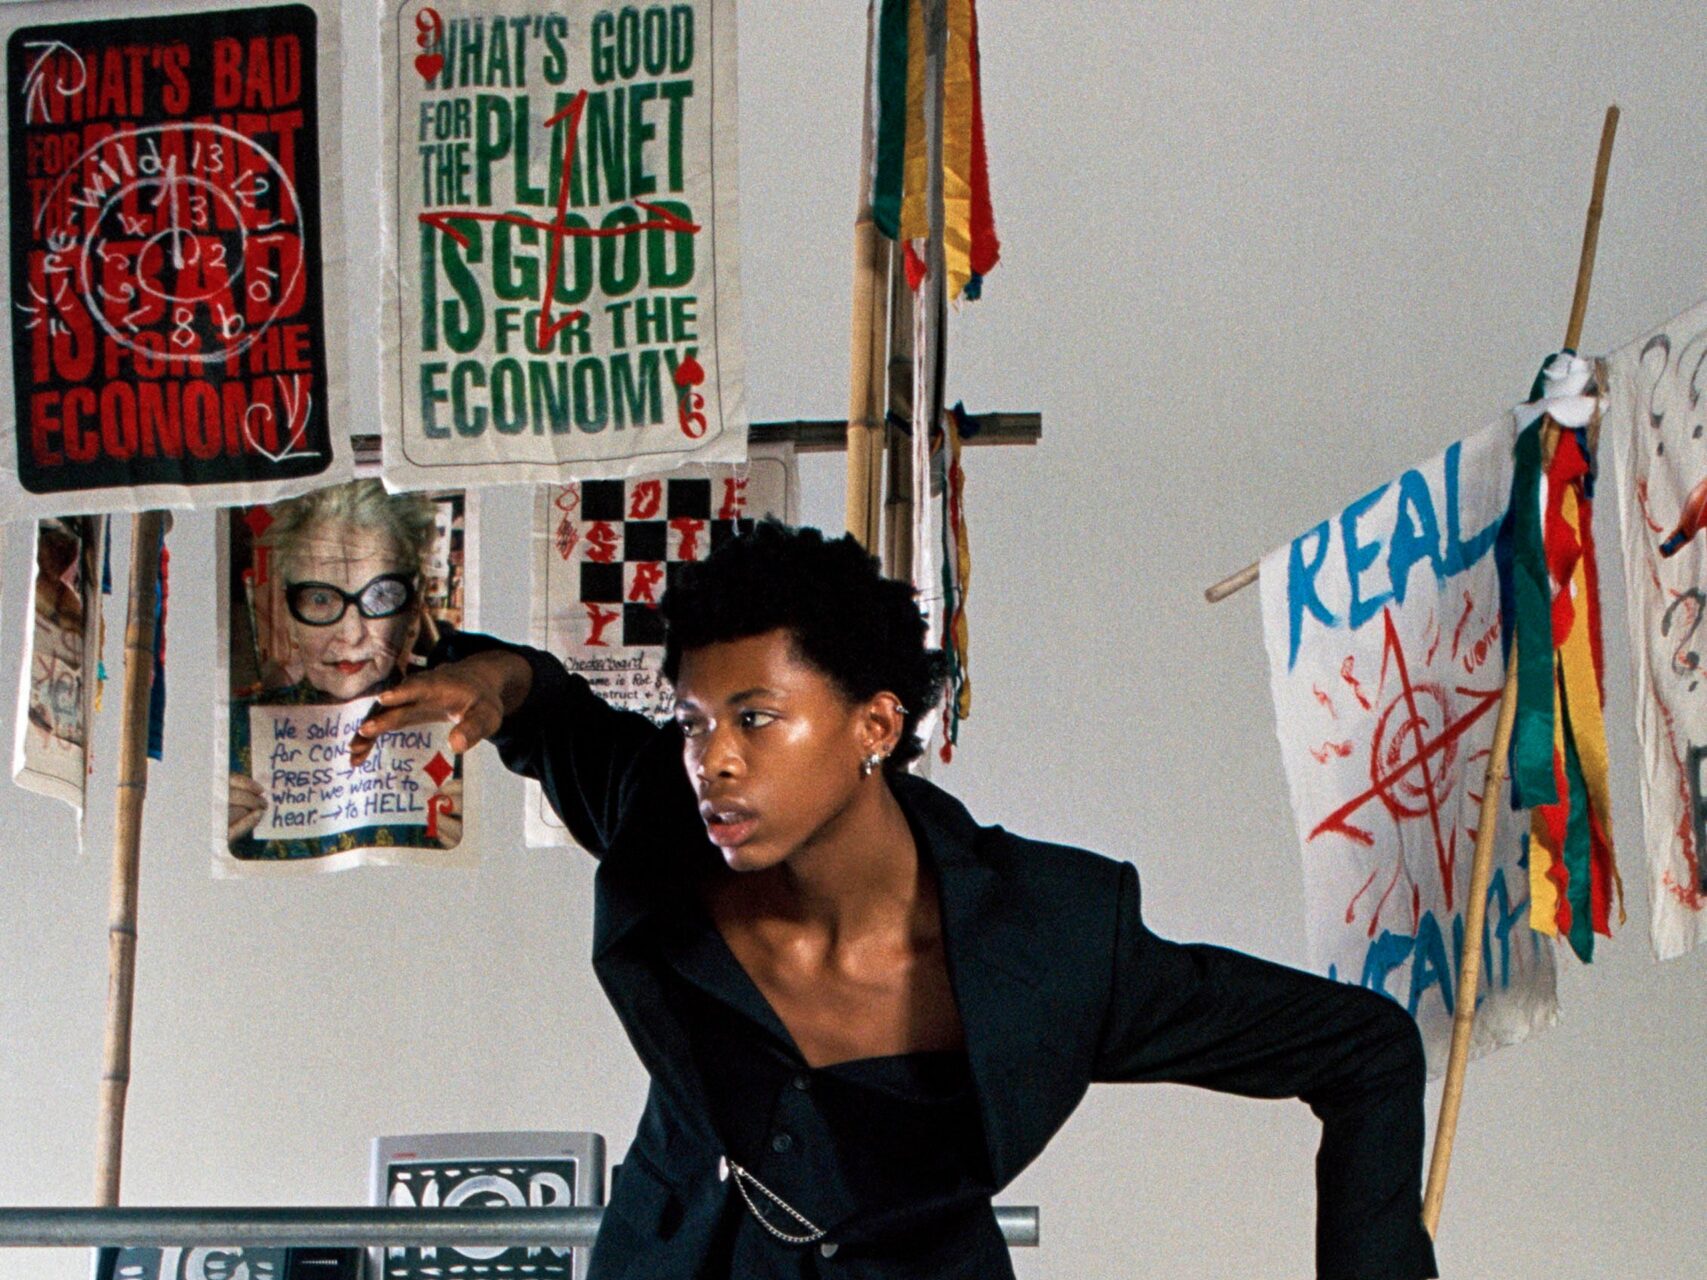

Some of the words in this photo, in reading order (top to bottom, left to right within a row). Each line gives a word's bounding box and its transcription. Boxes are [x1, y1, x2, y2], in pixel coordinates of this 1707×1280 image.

[415, 7, 443, 48] 9
[421, 12, 568, 90] WHAT'S
[591, 4, 695, 85] GOOD
[26, 40, 191, 124] WHAT'S
[213, 34, 303, 110] BAD
[192, 140, 225, 174] 13
[419, 98, 472, 142] FOR
[476, 80, 694, 207] PLANET
[27, 131, 80, 176] FOR
[82, 110, 304, 238] PLANET
[419, 142, 471, 207] THE
[27, 173, 80, 241] THE
[189, 194, 208, 227] 3
[208, 242, 227, 268] 2
[419, 212, 486, 354] IS
[492, 201, 695, 305] GOOD
[27, 246, 96, 384] IS
[102, 231, 306, 328] BAD
[172, 306, 196, 348] 8
[494, 306, 592, 355] FOR
[605, 297, 697, 349] THE
[105, 329, 202, 380] FOR
[214, 324, 310, 377] THE
[30, 374, 313, 467] ECONOMY
[420, 346, 698, 440] ECONOMY
[670, 517, 704, 561] T
[1287, 440, 1506, 675] REAL
[584, 602, 620, 647] Y
[273, 718, 298, 742] We
[306, 712, 341, 740] sold
[270, 742, 302, 770] for
[271, 768, 335, 789] PRESS
[391, 756, 416, 773] us
[271, 805, 318, 830] hear.
[344, 802, 360, 820] to
[363, 793, 427, 816] HELL
[272, 787, 318, 806] what
[320, 783, 345, 802] we
[349, 774, 398, 794] want
[401, 775, 420, 793] to
